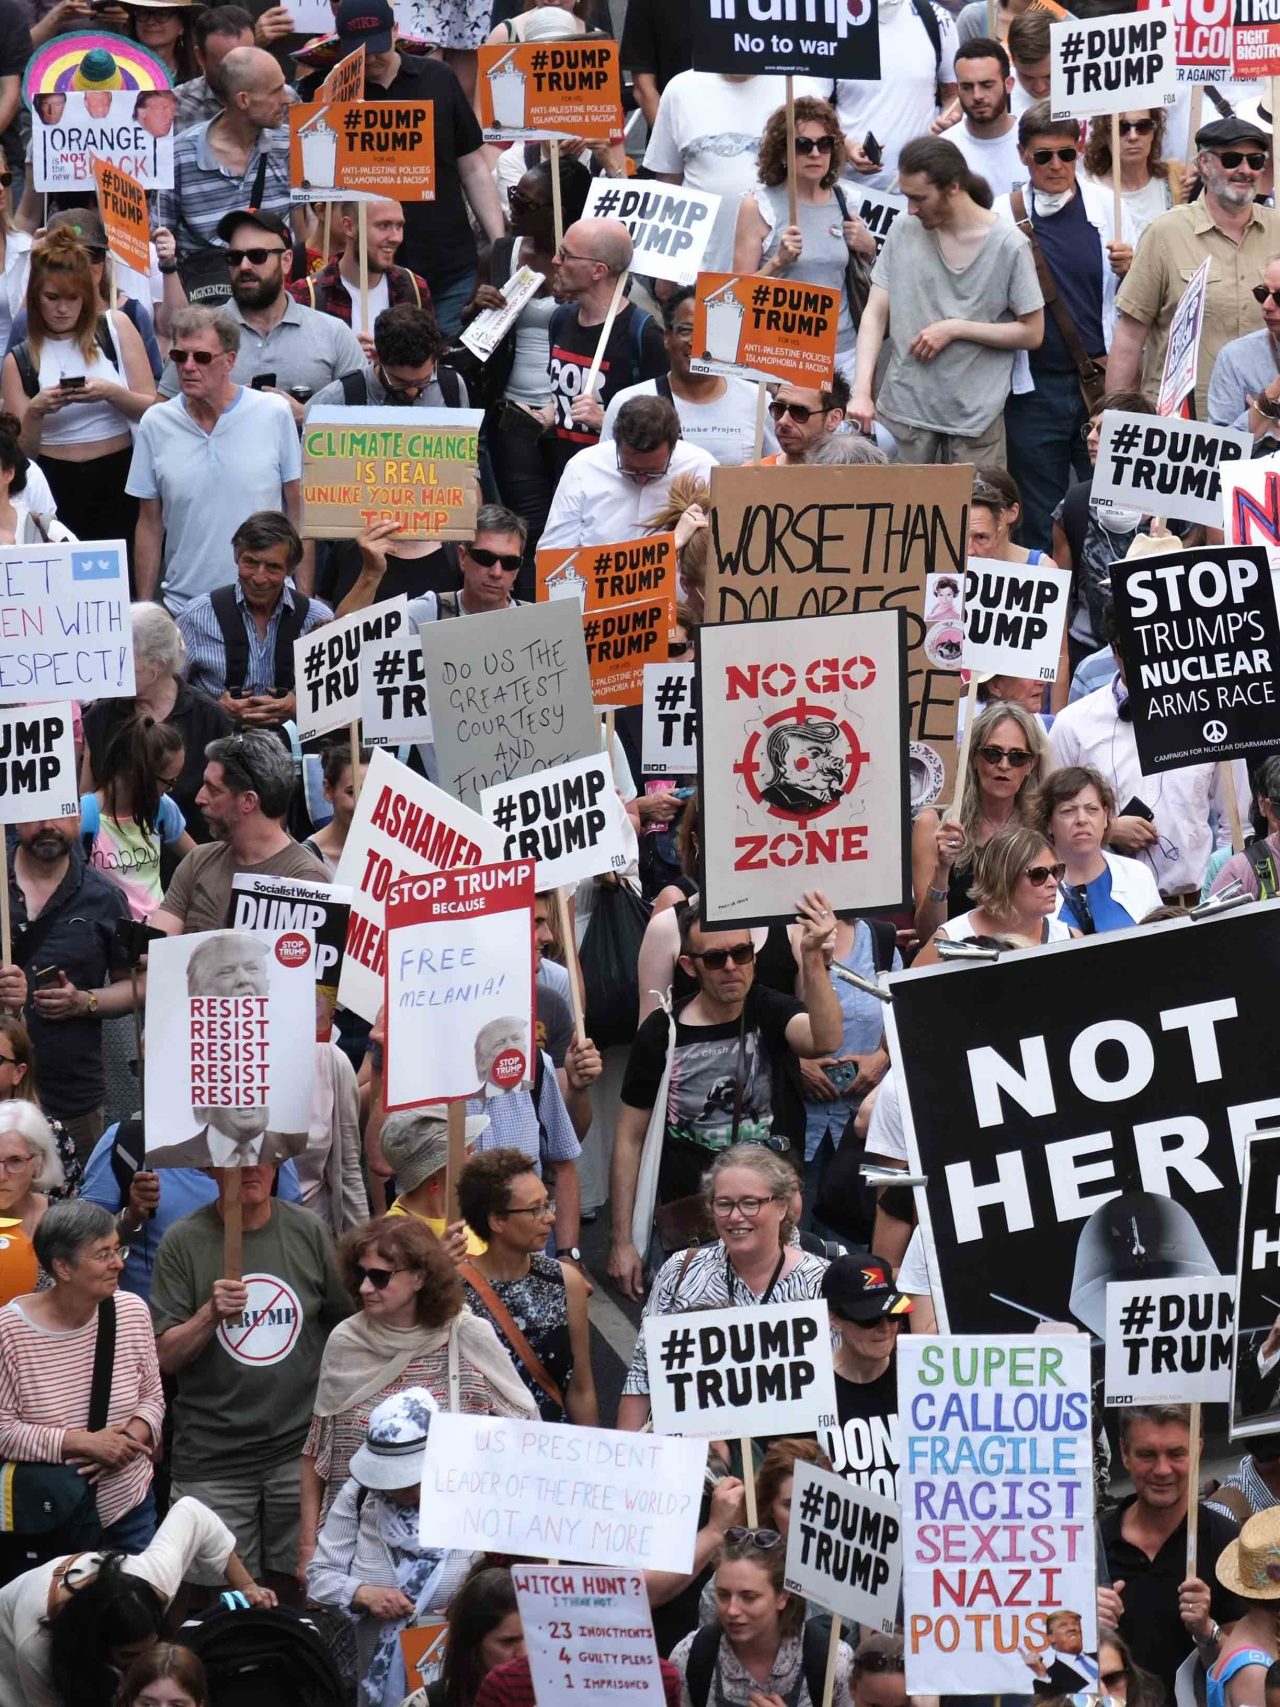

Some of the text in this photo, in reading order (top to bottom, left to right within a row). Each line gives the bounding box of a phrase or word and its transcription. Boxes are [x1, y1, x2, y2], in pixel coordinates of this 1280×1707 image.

[734, 33, 837, 56] No to war
[1060, 20, 1169, 64] #DUMP
[1237, 30, 1269, 44] FIGHT
[1062, 54, 1164, 96] TRUMP
[344, 108, 426, 129] #DUMP
[51, 127, 146, 151] ORANGE
[61, 153, 85, 163] NOT
[345, 131, 423, 151] TRUMP
[306, 431, 478, 461] CLIMATE CHANGE
[356, 460, 438, 485] IS REAL
[304, 486, 464, 506] UNLIKE YOUR HAIR
[711, 502, 969, 576] WORSE THAN
[1125, 558, 1260, 619] STOP
[56, 601, 123, 636] WITH
[1133, 610, 1266, 657] TRUMP'S
[442, 639, 567, 685] DO US THE
[726, 655, 876, 701] NO GO
[1139, 648, 1273, 690] NUCLEAR
[450, 671, 568, 714] GREATEST
[1147, 680, 1277, 721] ARMS RACE
[457, 704, 565, 744] COURTESY
[494, 738, 535, 765] AND
[1153, 749, 1188, 763] CAMPAIGN
[1189, 747, 1203, 756] FOR
[1203, 743, 1234, 754] NUCLEAR
[734, 826, 868, 872] ZONE
[389, 865, 531, 906] STOP TRUMP
[432, 897, 486, 915] BECAUSE
[400, 947, 477, 982] FREE
[190, 998, 270, 1018] RESIST
[399, 974, 506, 1009] MELANIA!
[190, 1020, 270, 1040] RESIST
[190, 1042, 270, 1062] RESIST
[965, 996, 1240, 1129] NOT
[190, 1064, 270, 1084] RESIST
[190, 1086, 270, 1106] RESIST
[659, 1317, 819, 1371] #DUMP
[918, 1345, 1066, 1387] SUPER
[666, 1360, 816, 1413] TRUMP
[911, 1392, 1088, 1433] CALLOUS
[475, 1430, 664, 1470] US PRESIDENT
[908, 1435, 1078, 1477] FRAGILE
[435, 1469, 691, 1516] LEADER OF THE FREE WORLD?
[915, 1480, 1082, 1521] RACIST
[462, 1507, 654, 1556] NOT ANY MORE
[915, 1525, 1084, 1565] SEXIST
[514, 1575, 574, 1594] WITCH
[932, 1567, 1063, 1608] NAZI
[548, 1622, 653, 1639] 23 INDICTMENTS
[910, 1612, 1052, 1656] POTUS
[559, 1647, 653, 1665] 4 GUILTY PLEAS
[564, 1674, 649, 1690] 1 IMPRISONED
